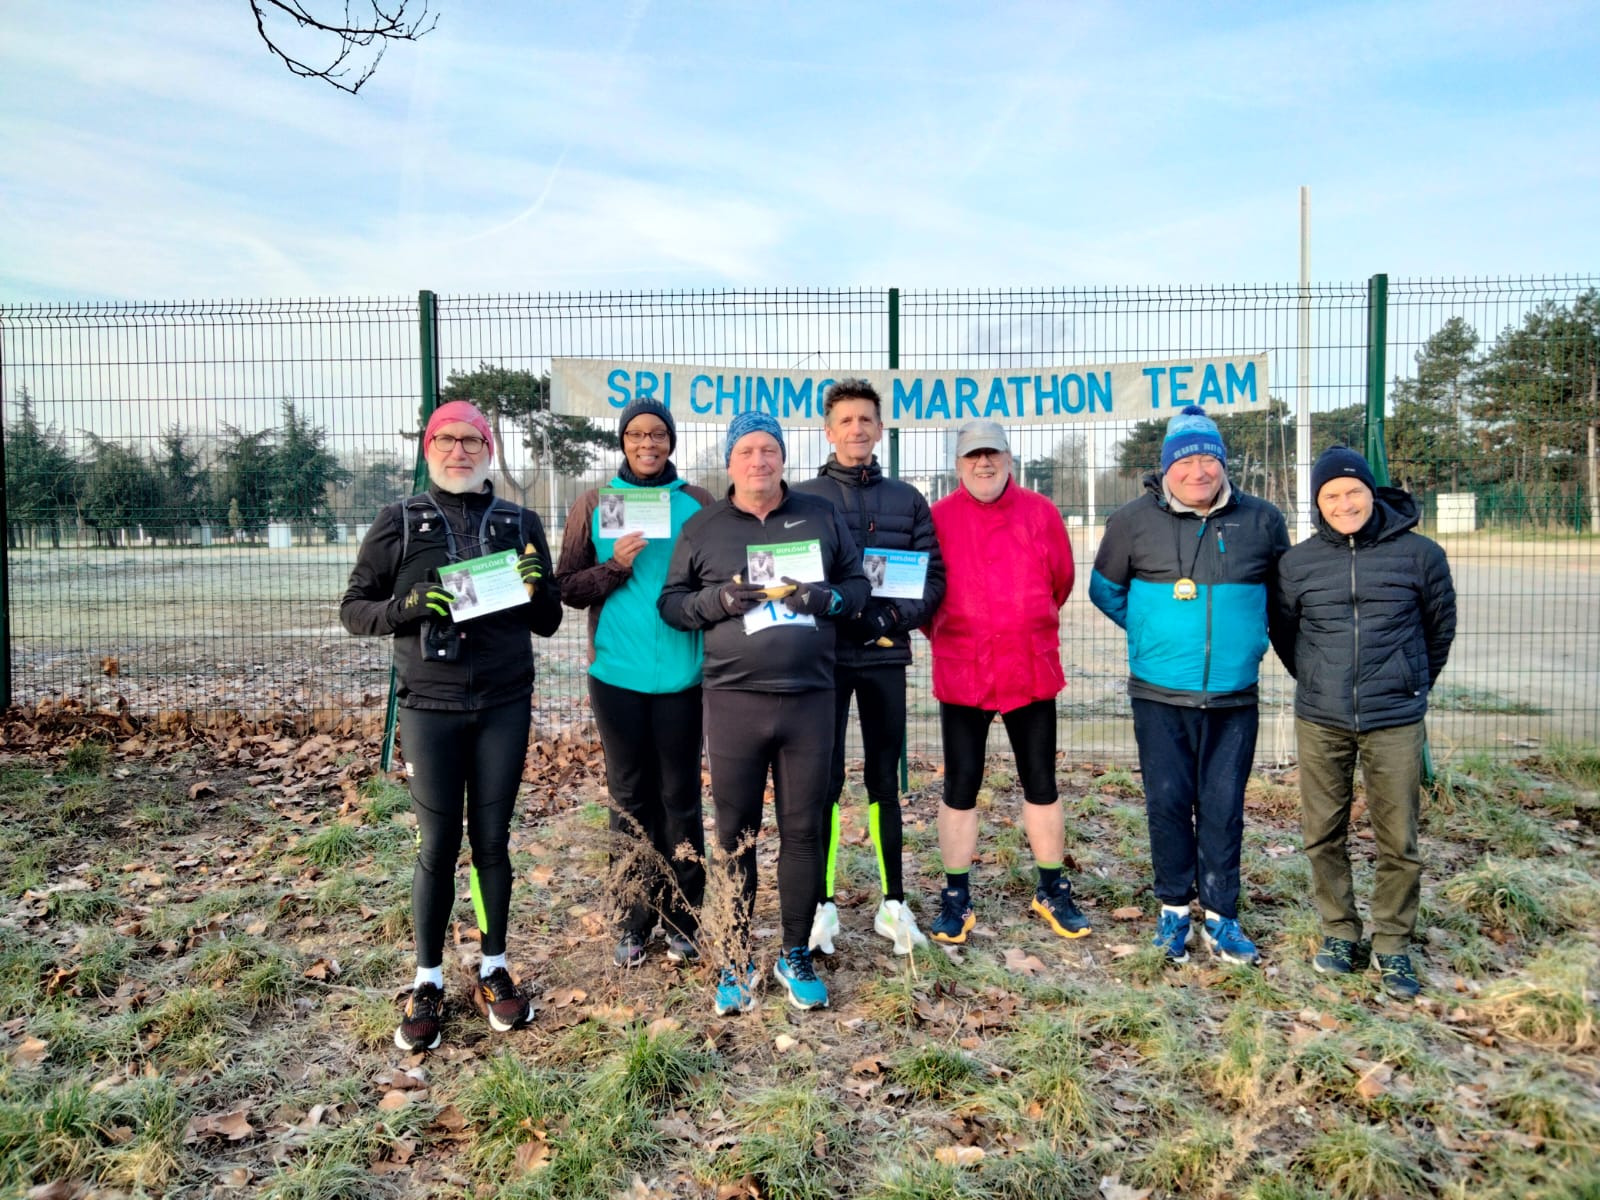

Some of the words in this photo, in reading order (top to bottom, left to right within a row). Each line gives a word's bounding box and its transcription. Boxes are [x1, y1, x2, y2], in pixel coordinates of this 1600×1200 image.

[607, 369, 672, 409] SRI
[893, 371, 1113, 420] MARATHON
[1142, 361, 1258, 408] TEAM
